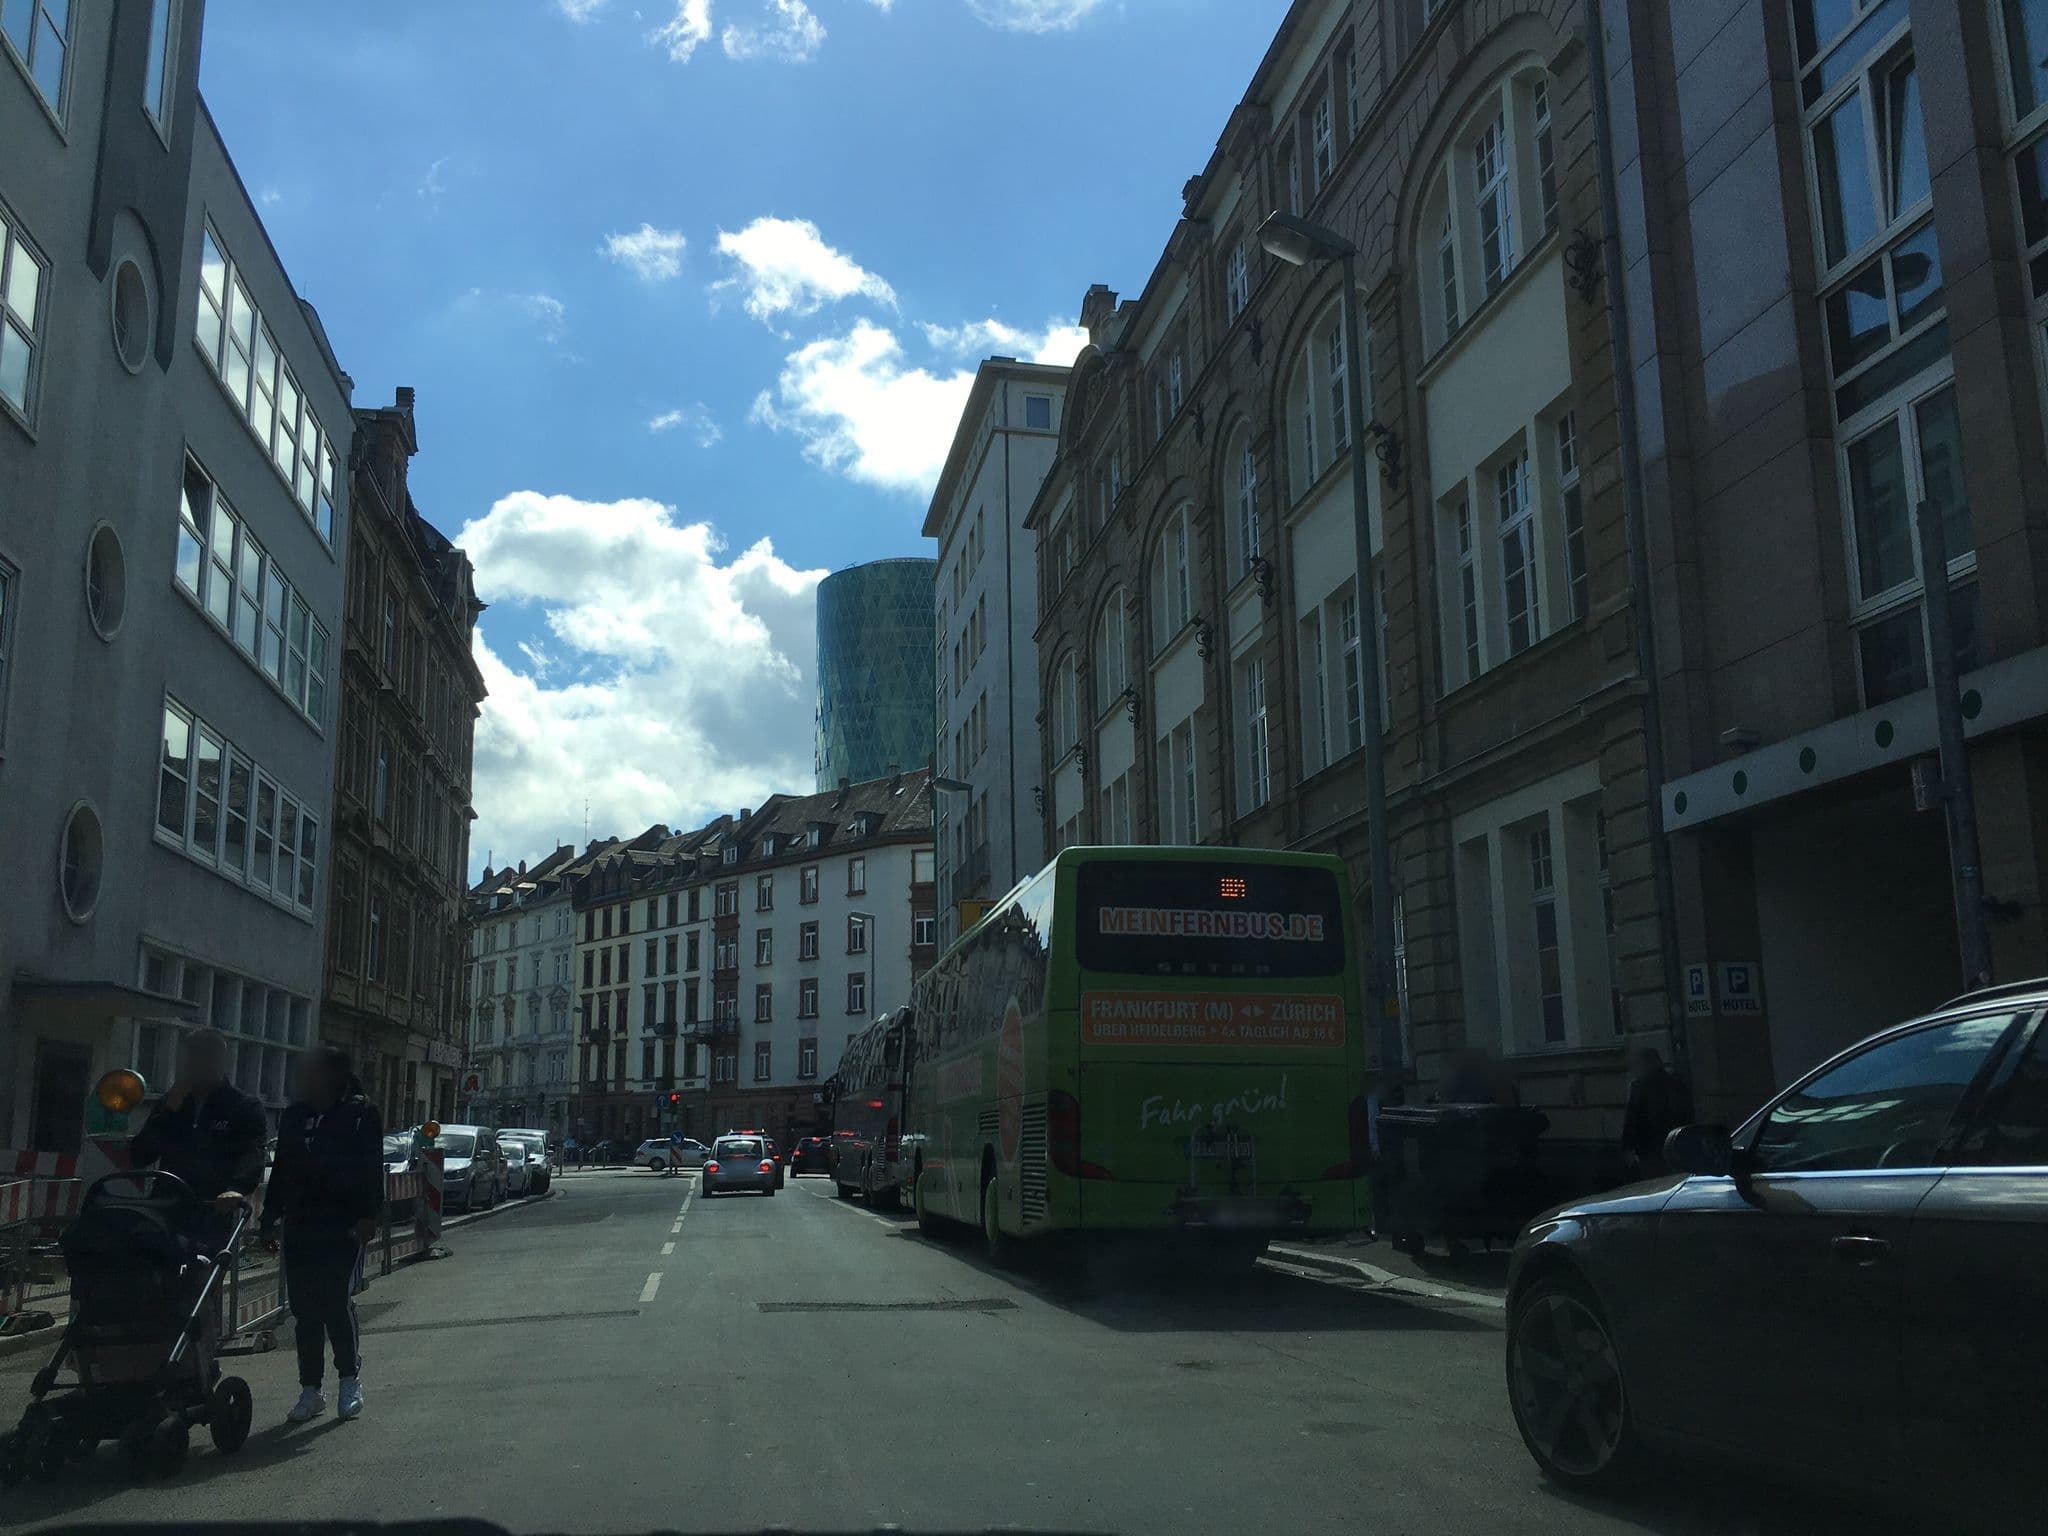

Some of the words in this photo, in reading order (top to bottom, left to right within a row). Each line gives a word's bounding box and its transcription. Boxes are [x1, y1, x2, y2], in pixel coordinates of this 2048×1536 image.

[1100, 907, 1323, 941] MEINFERNBUS.DE
[1731, 971, 1744, 990] P
[1091, 999, 1199, 1019] FRANKFURT
[1204, 1001, 1233, 1022] (M)
[1271, 1000, 1336, 1022] ZÜRICH
[1688, 999, 1710, 1012] HOTEL
[1722, 998, 1760, 1011] HOTEL
[1130, 1022, 1206, 1038] HEIDELBERG
[1140, 1095, 1202, 1130] Fahr
[1211, 1072, 1288, 1127] grün!
